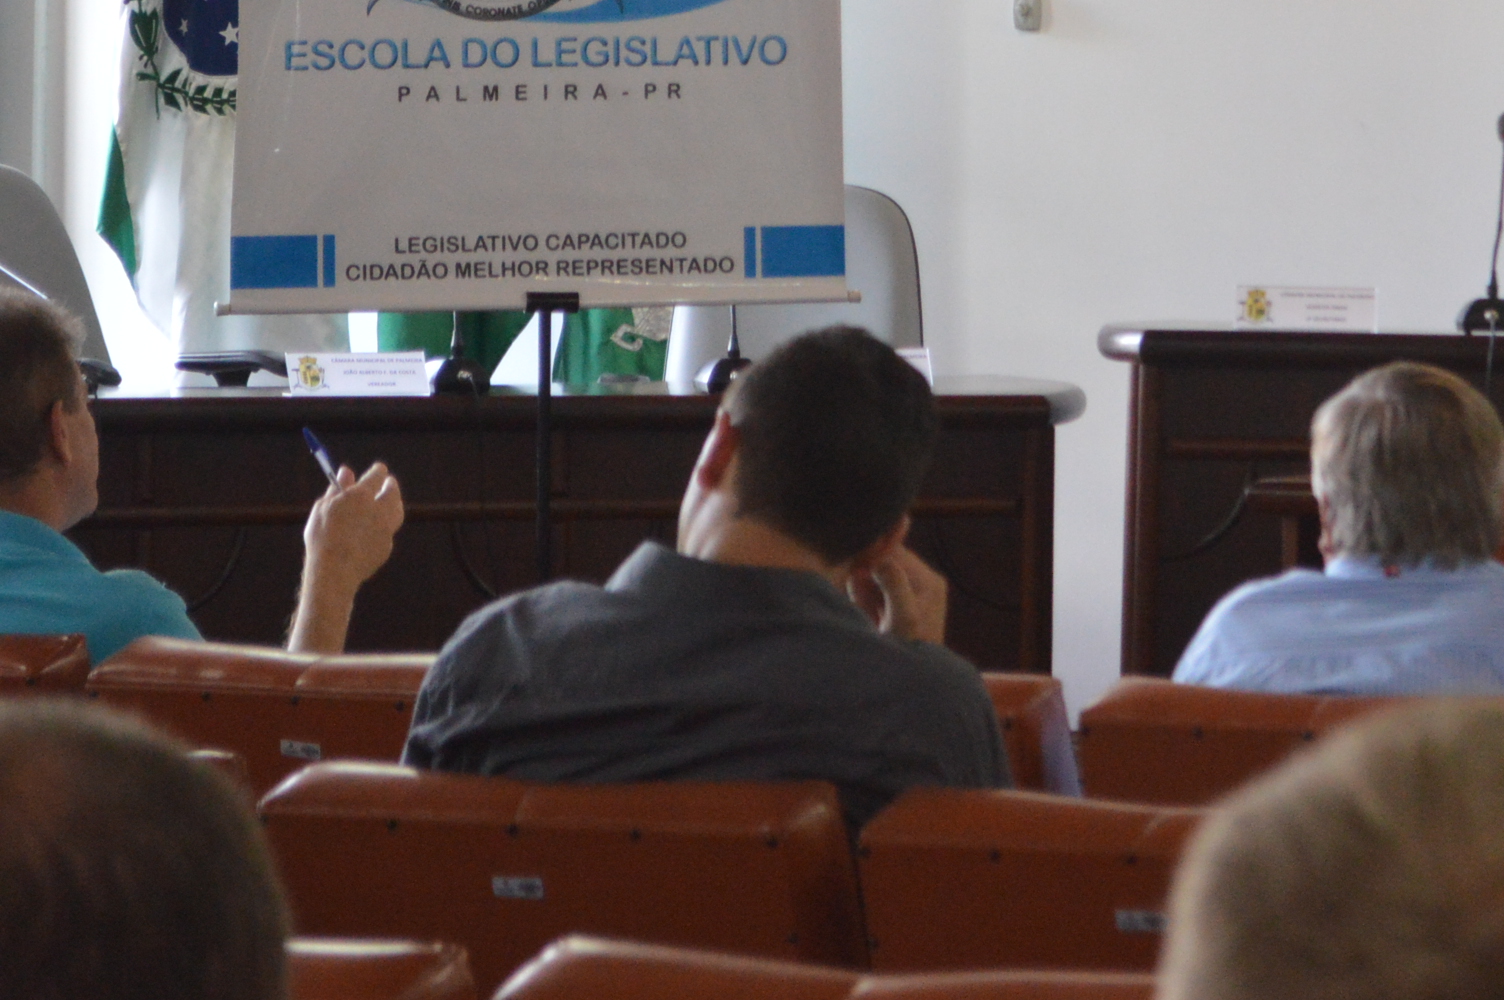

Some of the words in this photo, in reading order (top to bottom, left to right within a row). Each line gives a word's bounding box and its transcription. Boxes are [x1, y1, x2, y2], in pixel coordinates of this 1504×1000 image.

[284, 38, 450, 71] ESCOLA
[461, 37, 521, 69] DO
[531, 35, 788, 69] LEGISLATIVO
[394, 234, 539, 255] LEGISLATIVO
[545, 231, 687, 251] CAPACITADO
[345, 259, 449, 281] CIDADÃO
[455, 260, 550, 279] MELHOR
[556, 256, 735, 277] REPRESENTADO
